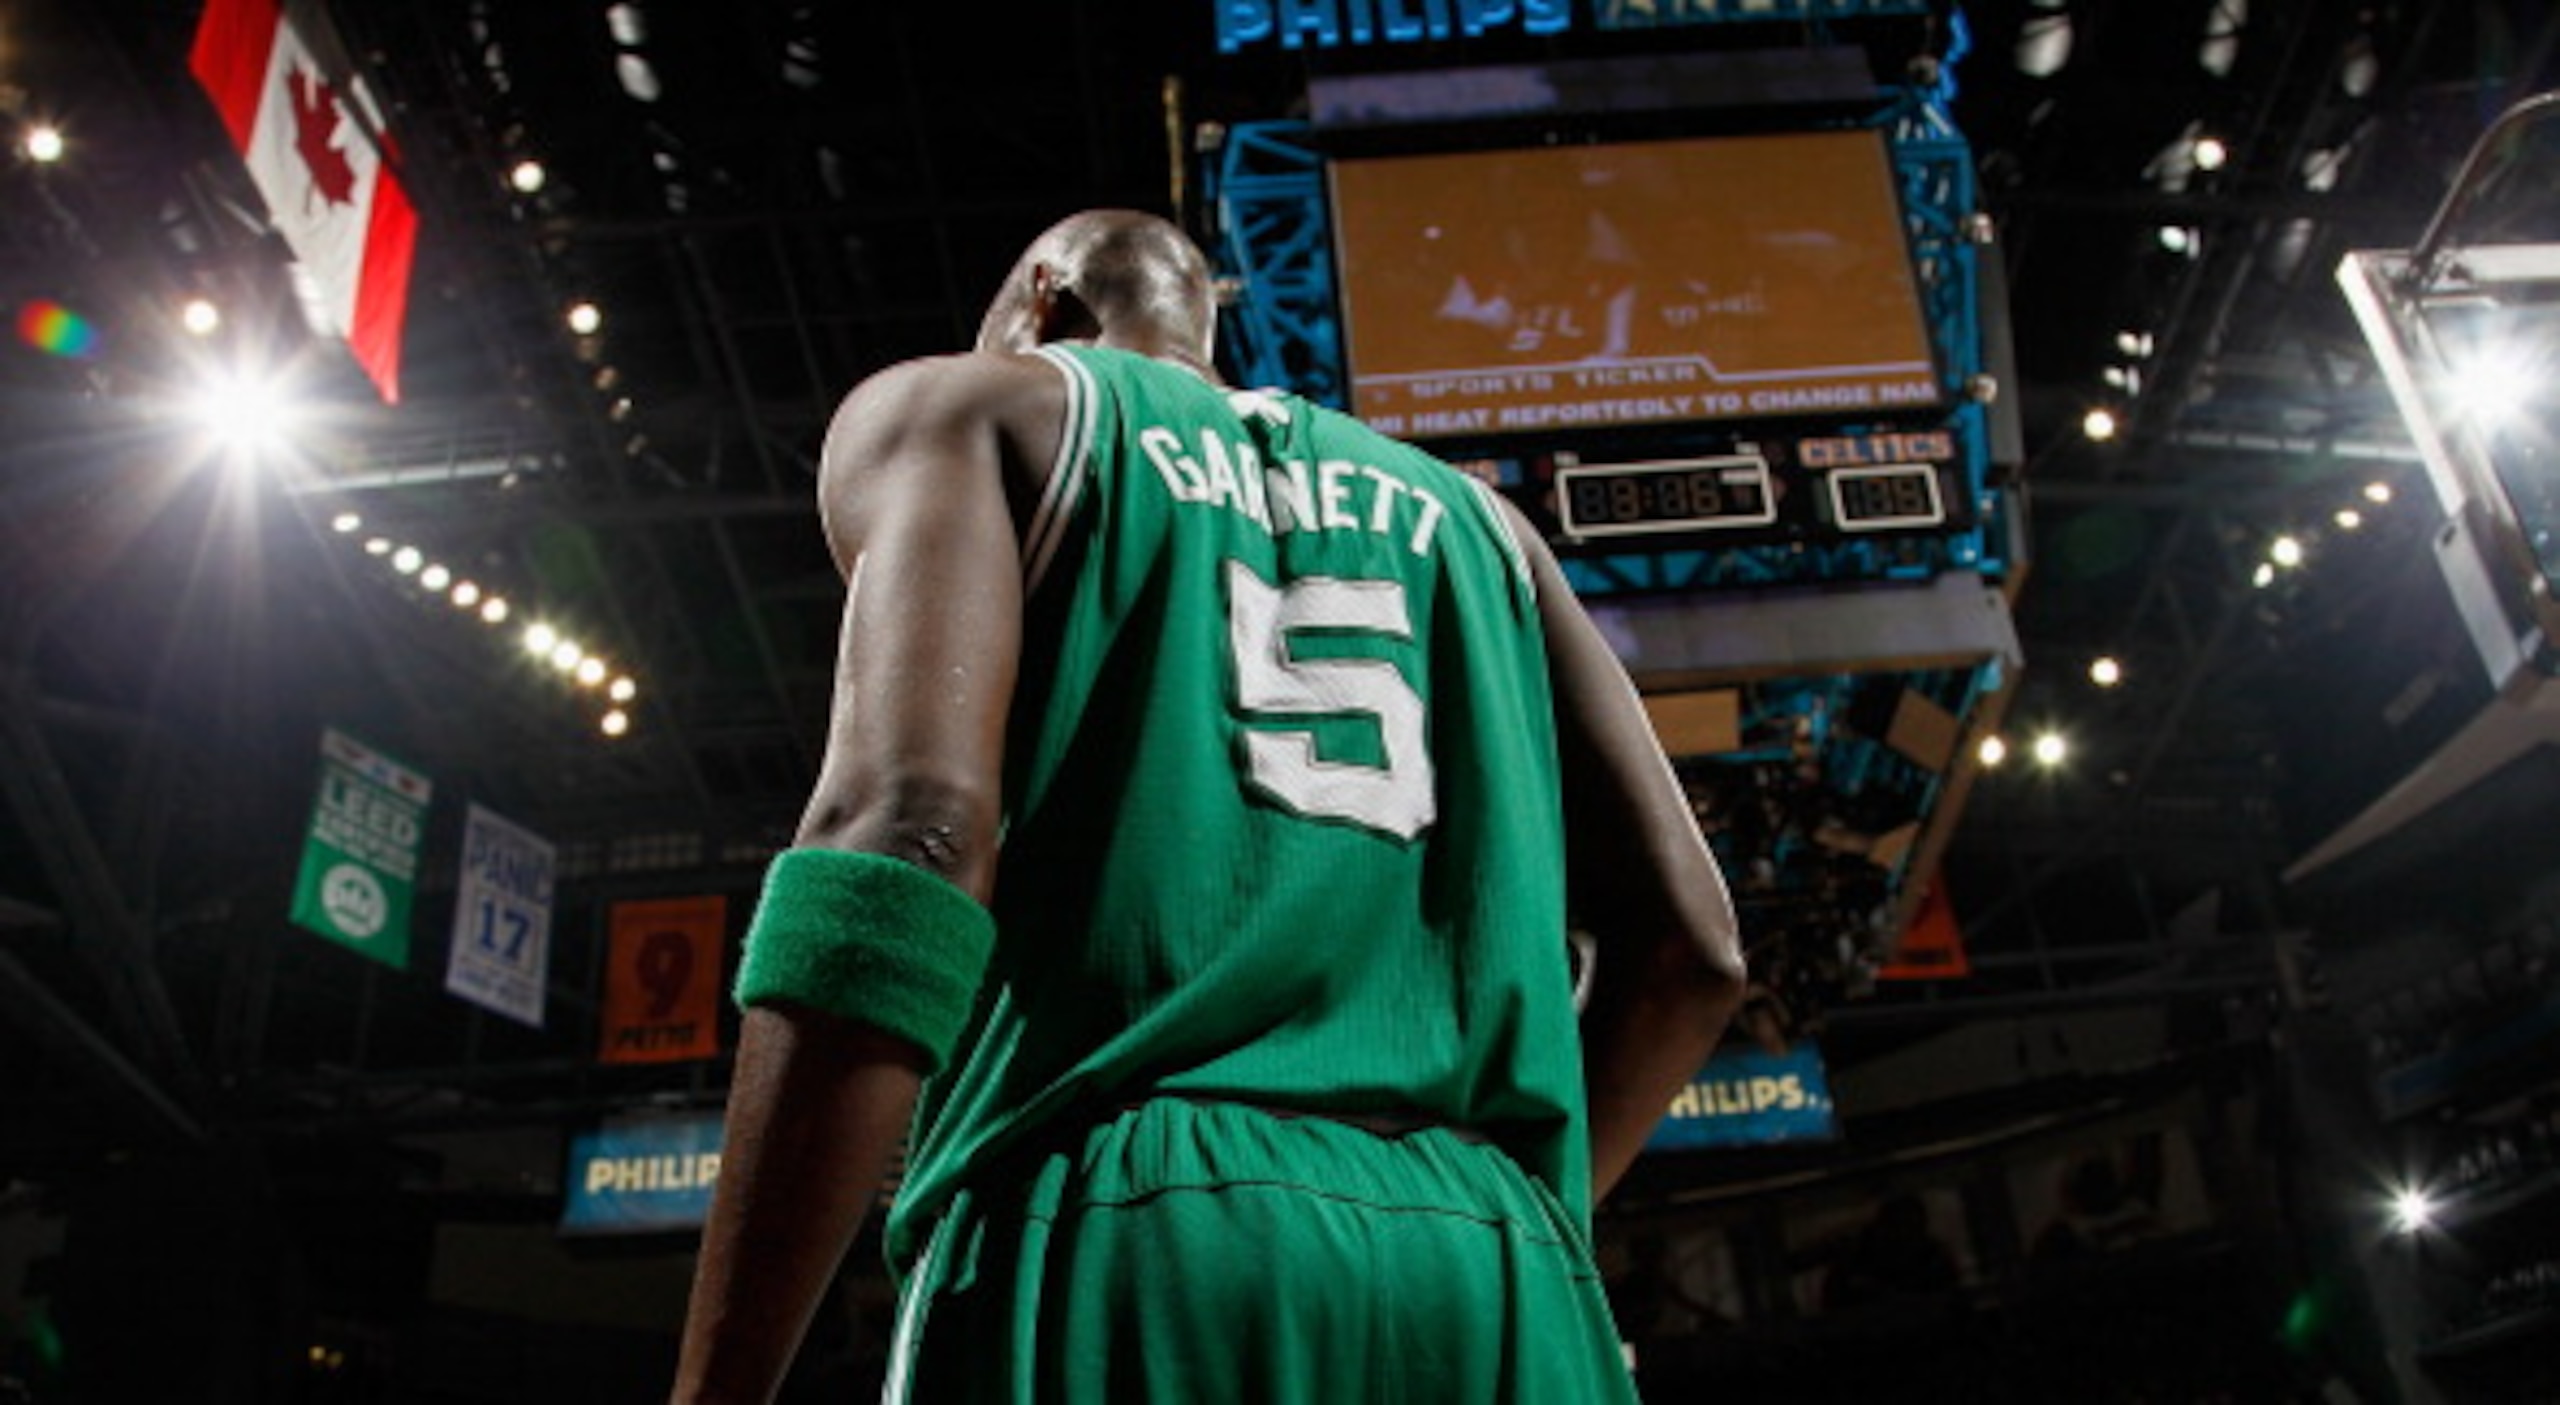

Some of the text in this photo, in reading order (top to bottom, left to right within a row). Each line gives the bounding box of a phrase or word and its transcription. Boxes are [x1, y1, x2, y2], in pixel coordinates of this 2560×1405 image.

[1411, 363, 1697, 398] SPORTS TICKER
[1411, 409, 1492, 432] HEAT
[1500, 395, 1696, 428] REPORTEDLY
[1703, 392, 1743, 414] TO
[1748, 384, 1872, 411] CHANGE
[1801, 432, 1953, 468] CELTICS
[1228, 557, 1438, 841] 5
[320, 774, 418, 848] LEED
[481, 898, 530, 963] 17
[636, 928, 696, 1020] 9
